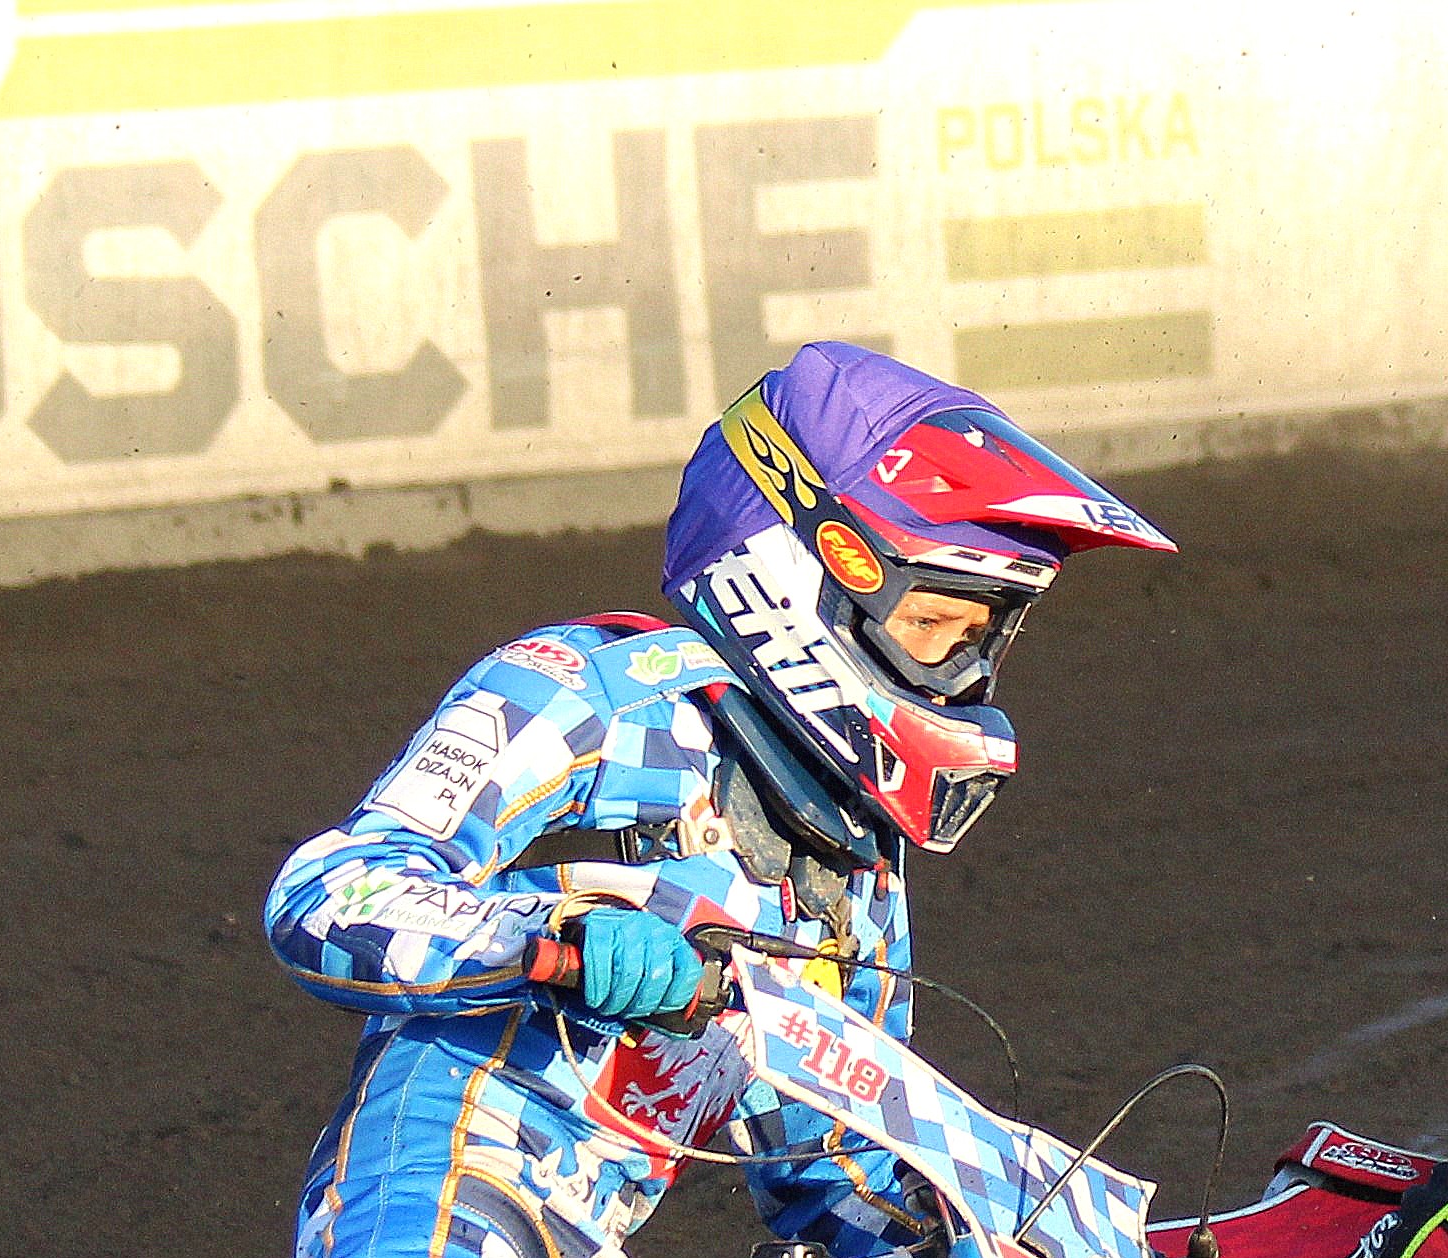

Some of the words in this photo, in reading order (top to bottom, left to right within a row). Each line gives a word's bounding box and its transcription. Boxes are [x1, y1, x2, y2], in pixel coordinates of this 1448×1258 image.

[935, 90, 1203, 173] POLSKA
[820, 530, 879, 582] FMF
[416, 756, 478, 793] DIZAJN
[426, 738, 491, 775] HASIOK
[775, 1010, 892, 1104] #118
